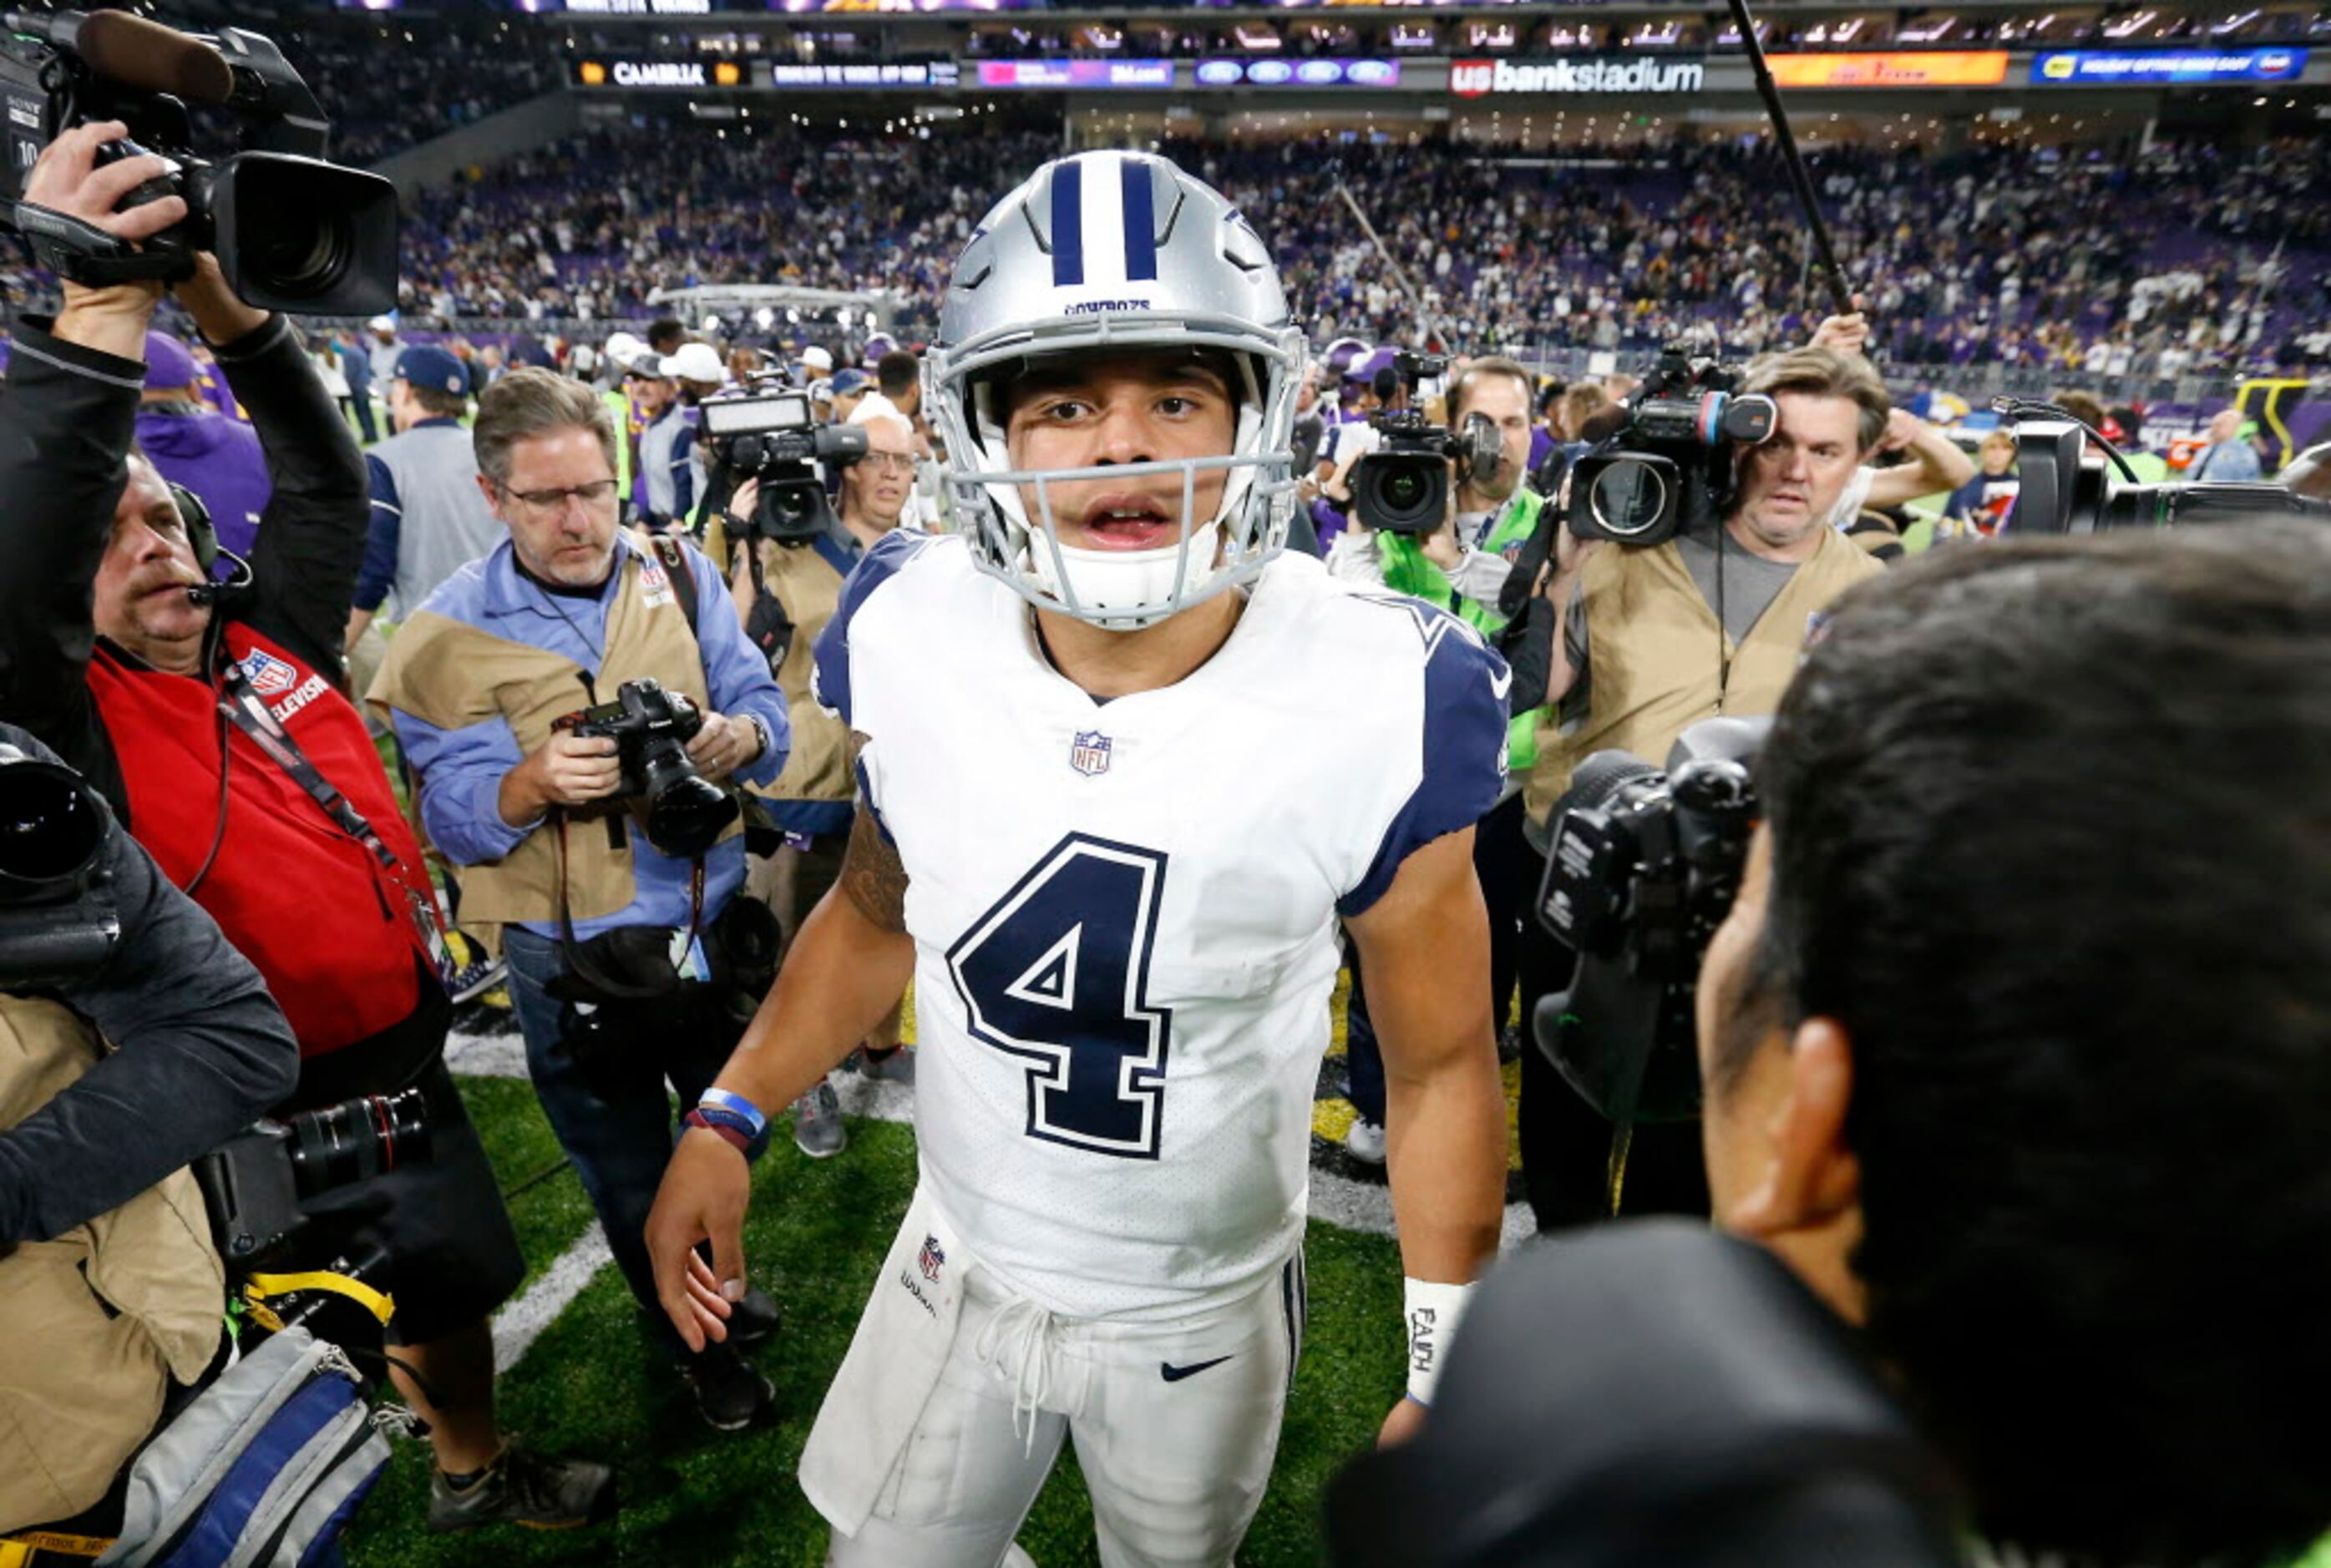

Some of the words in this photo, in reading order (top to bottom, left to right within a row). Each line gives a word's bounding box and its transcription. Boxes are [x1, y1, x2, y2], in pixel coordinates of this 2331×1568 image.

[252, 665, 291, 691] NFL
[1075, 748, 1105, 771] NFL
[945, 830, 1173, 1161] 4
[920, 1247, 941, 1280] NFL
